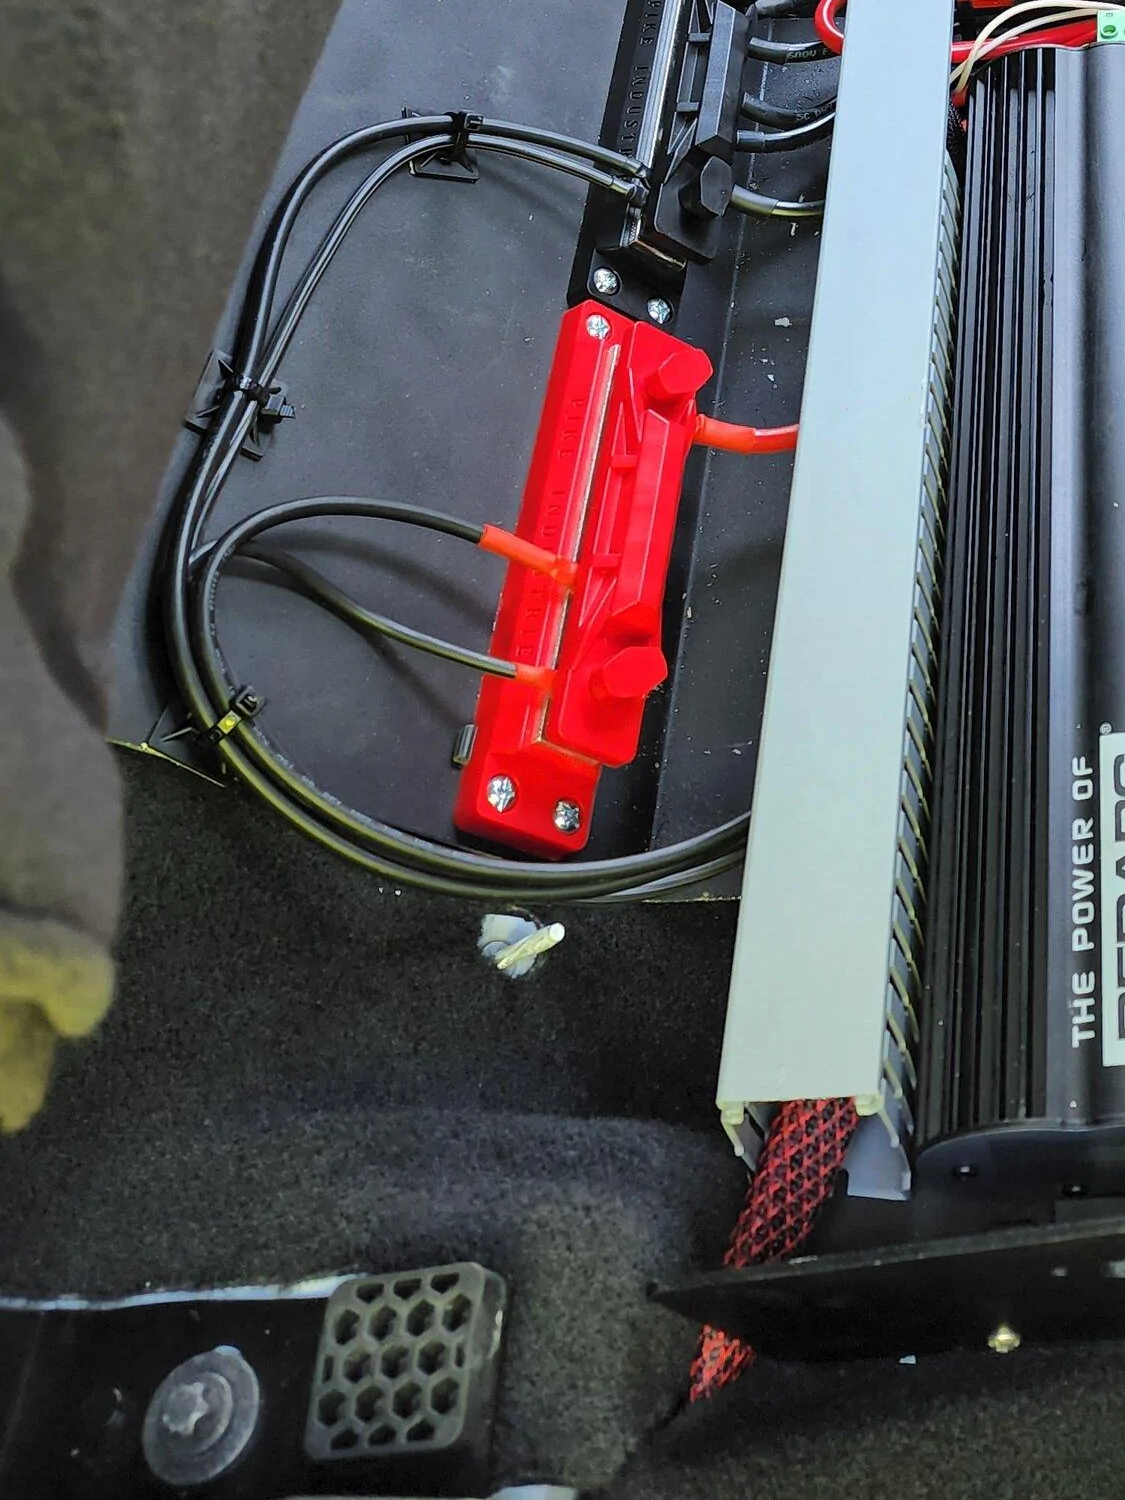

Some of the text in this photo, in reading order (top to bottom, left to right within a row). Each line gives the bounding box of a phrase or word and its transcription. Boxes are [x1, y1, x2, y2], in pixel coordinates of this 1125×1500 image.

[619, 65, 650, 158] INDUSTR
[1071, 754, 1096, 1048] THE POWER OF
